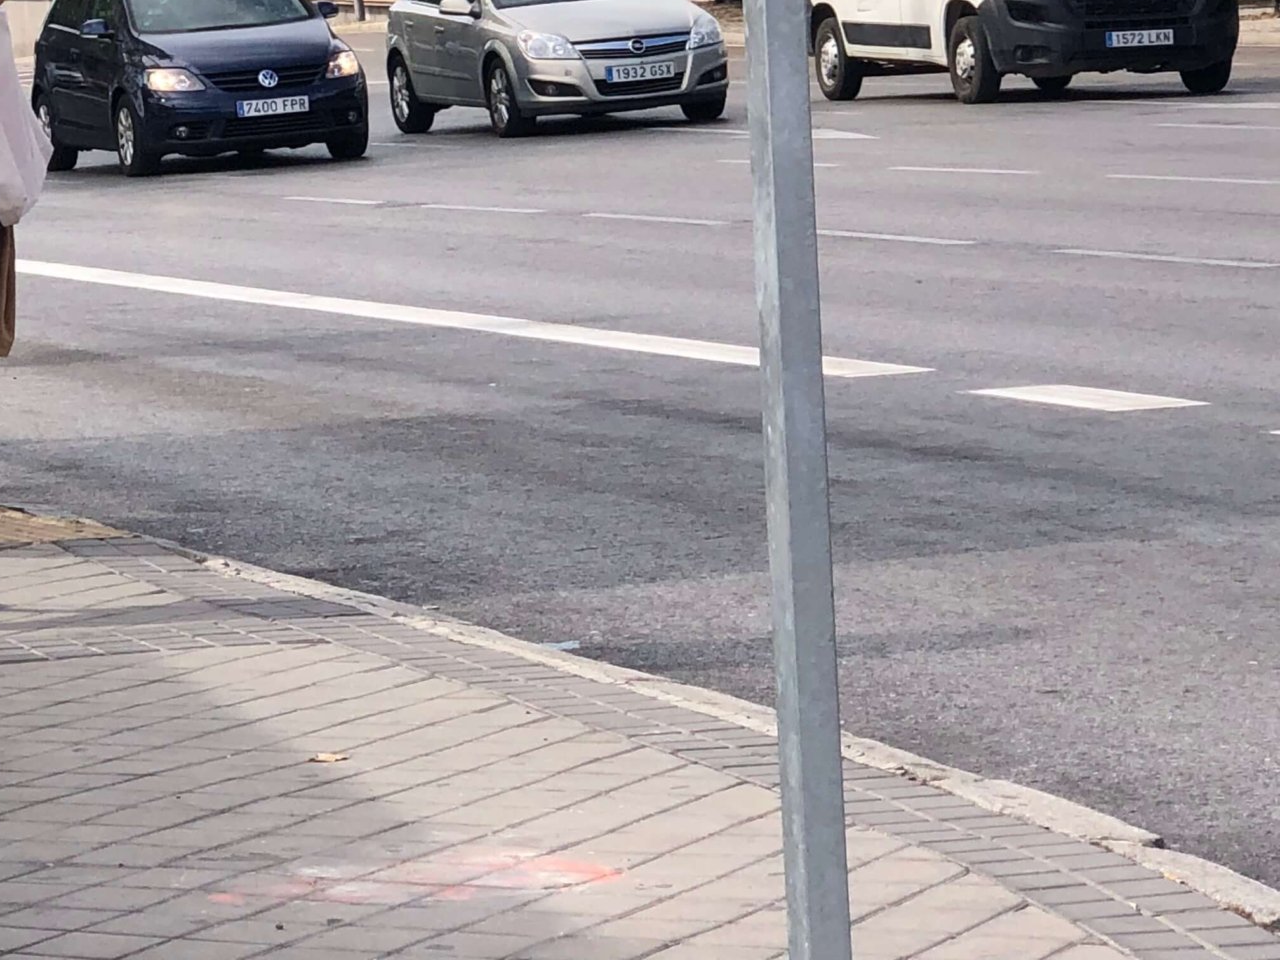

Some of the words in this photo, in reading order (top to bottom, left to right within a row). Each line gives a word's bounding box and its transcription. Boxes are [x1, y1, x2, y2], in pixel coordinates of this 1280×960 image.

[1116, 33, 1144, 45] 1572
[1148, 31, 1171, 43] LKN
[616, 66, 646, 79] 1932
[246, 100, 278, 114] 7400
[283, 98, 306, 112] FPR
